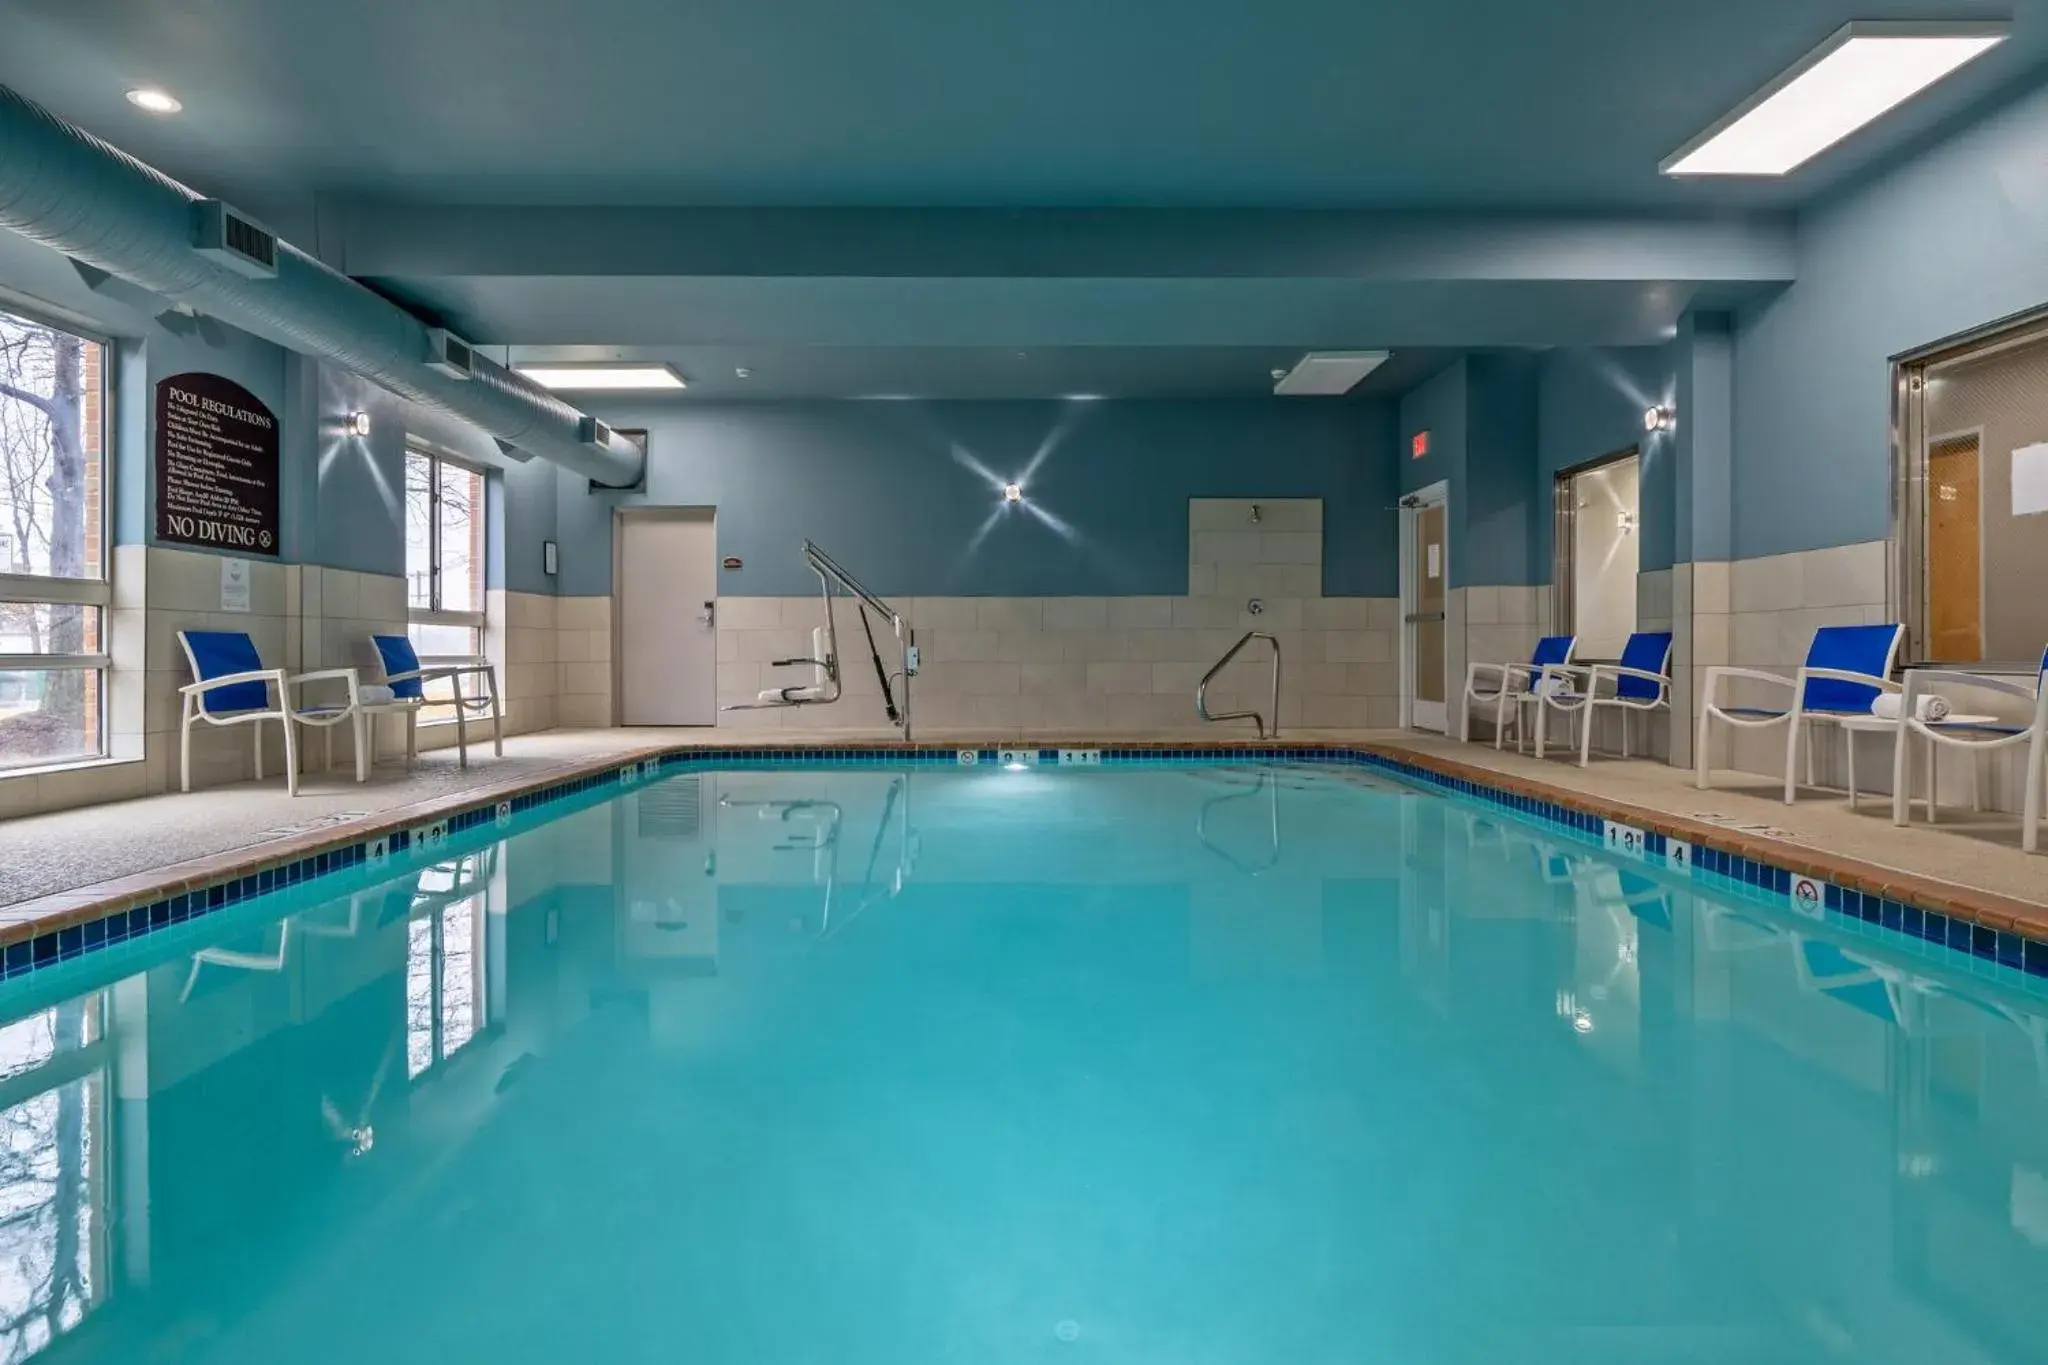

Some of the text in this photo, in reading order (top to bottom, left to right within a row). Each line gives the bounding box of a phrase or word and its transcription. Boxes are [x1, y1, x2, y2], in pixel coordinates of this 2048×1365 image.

[169, 387, 272, 429] POOL REGULATIONS
[168, 515, 256, 546] NO DIVING
